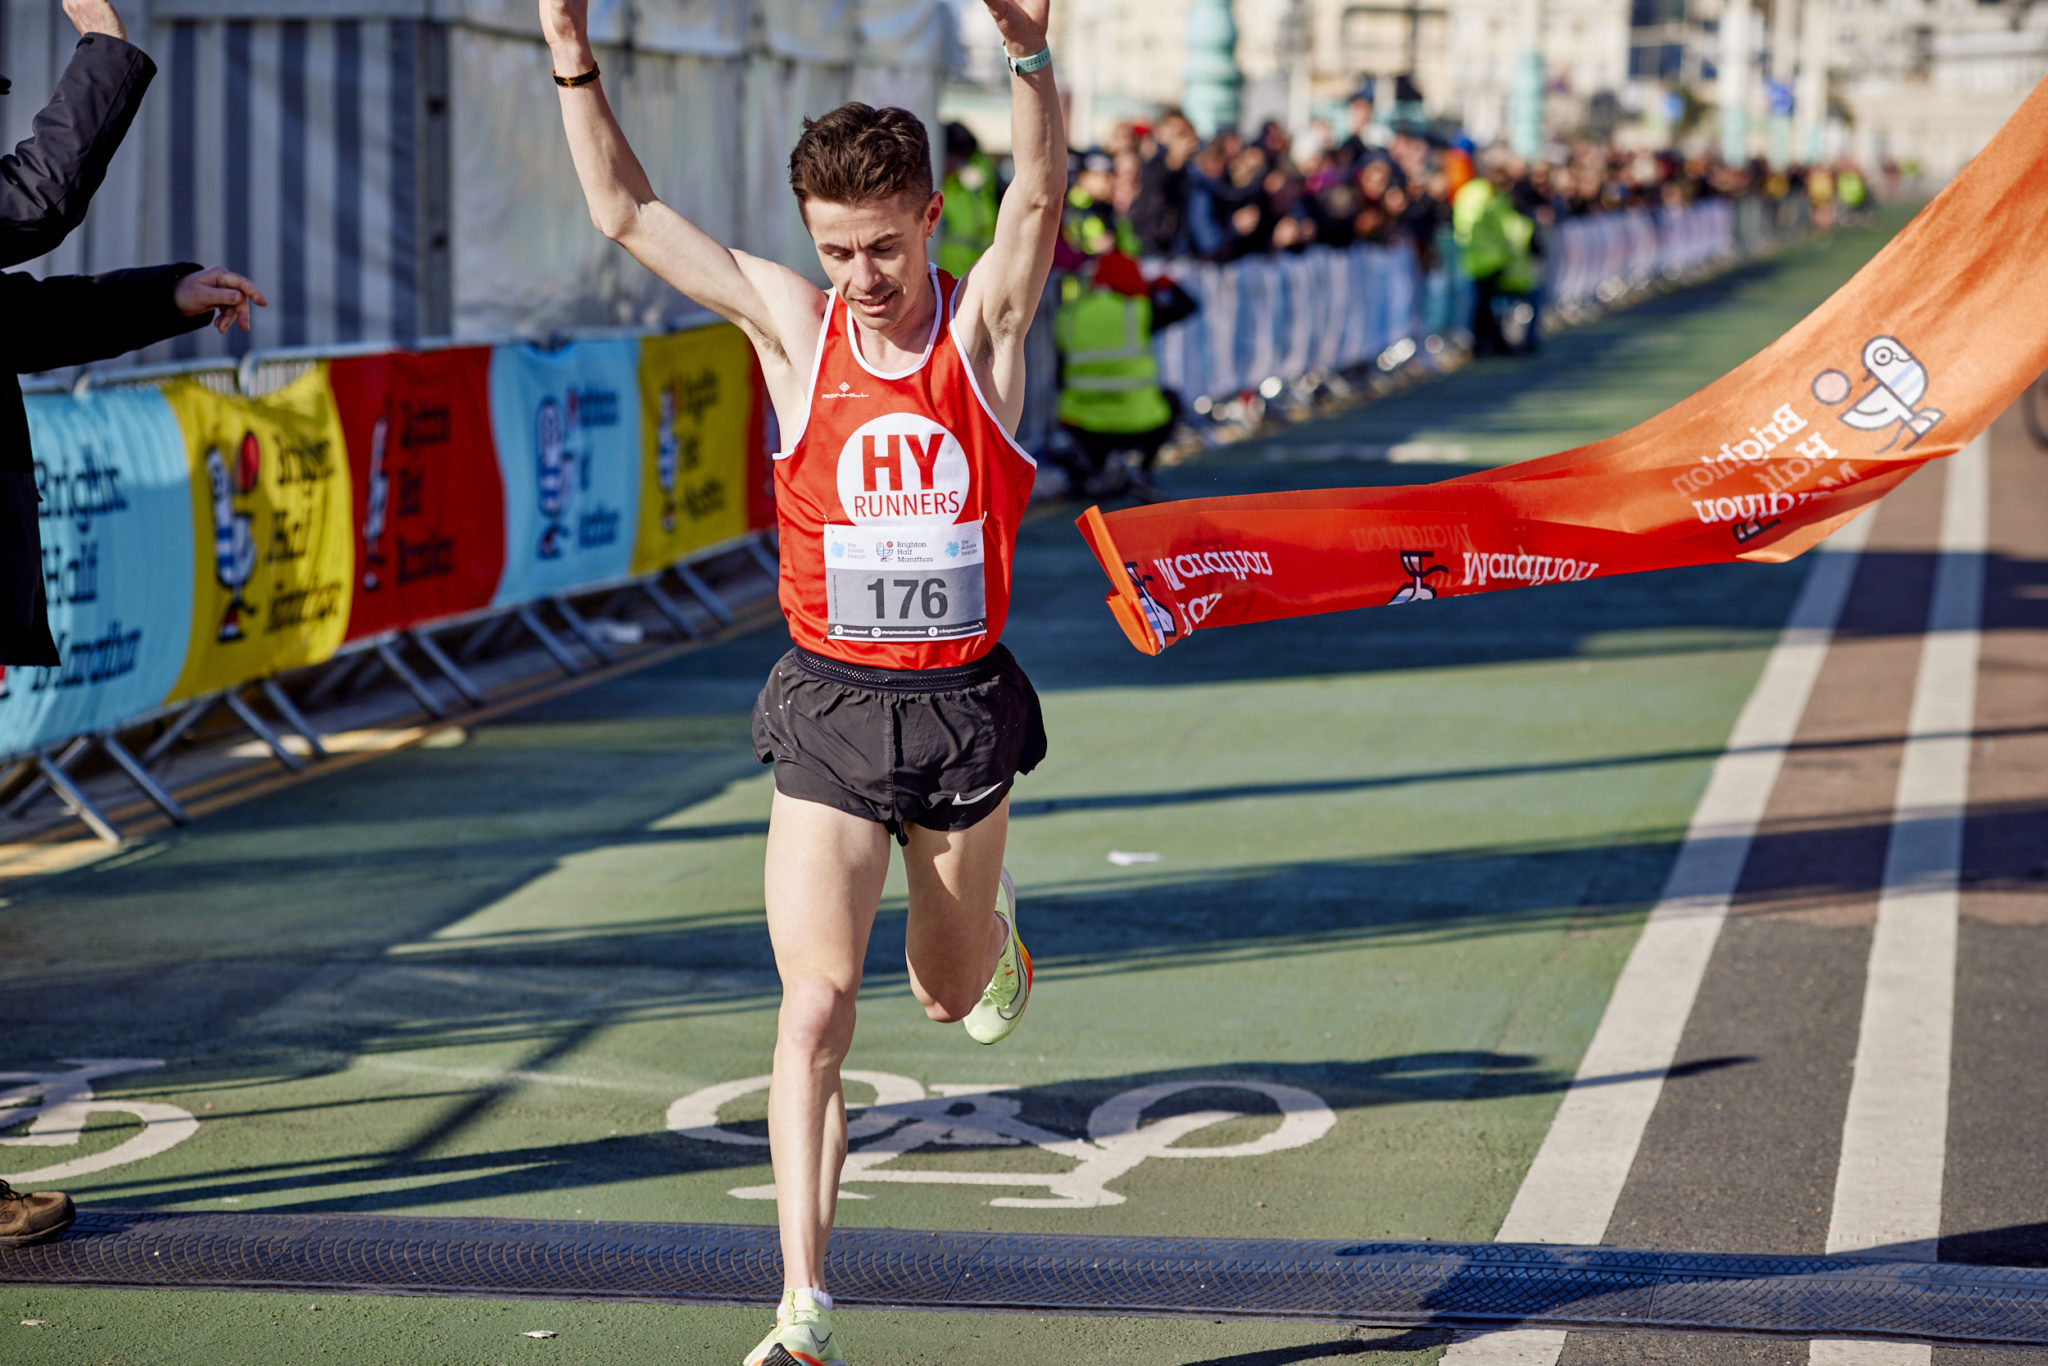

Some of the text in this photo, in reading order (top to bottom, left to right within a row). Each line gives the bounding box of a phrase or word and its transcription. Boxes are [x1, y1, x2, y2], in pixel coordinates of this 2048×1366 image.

[862, 433, 946, 492] HY
[854, 490, 960, 518] RUNNERS
[897, 541, 927, 549] Brighton
[867, 578, 949, 619] 176
